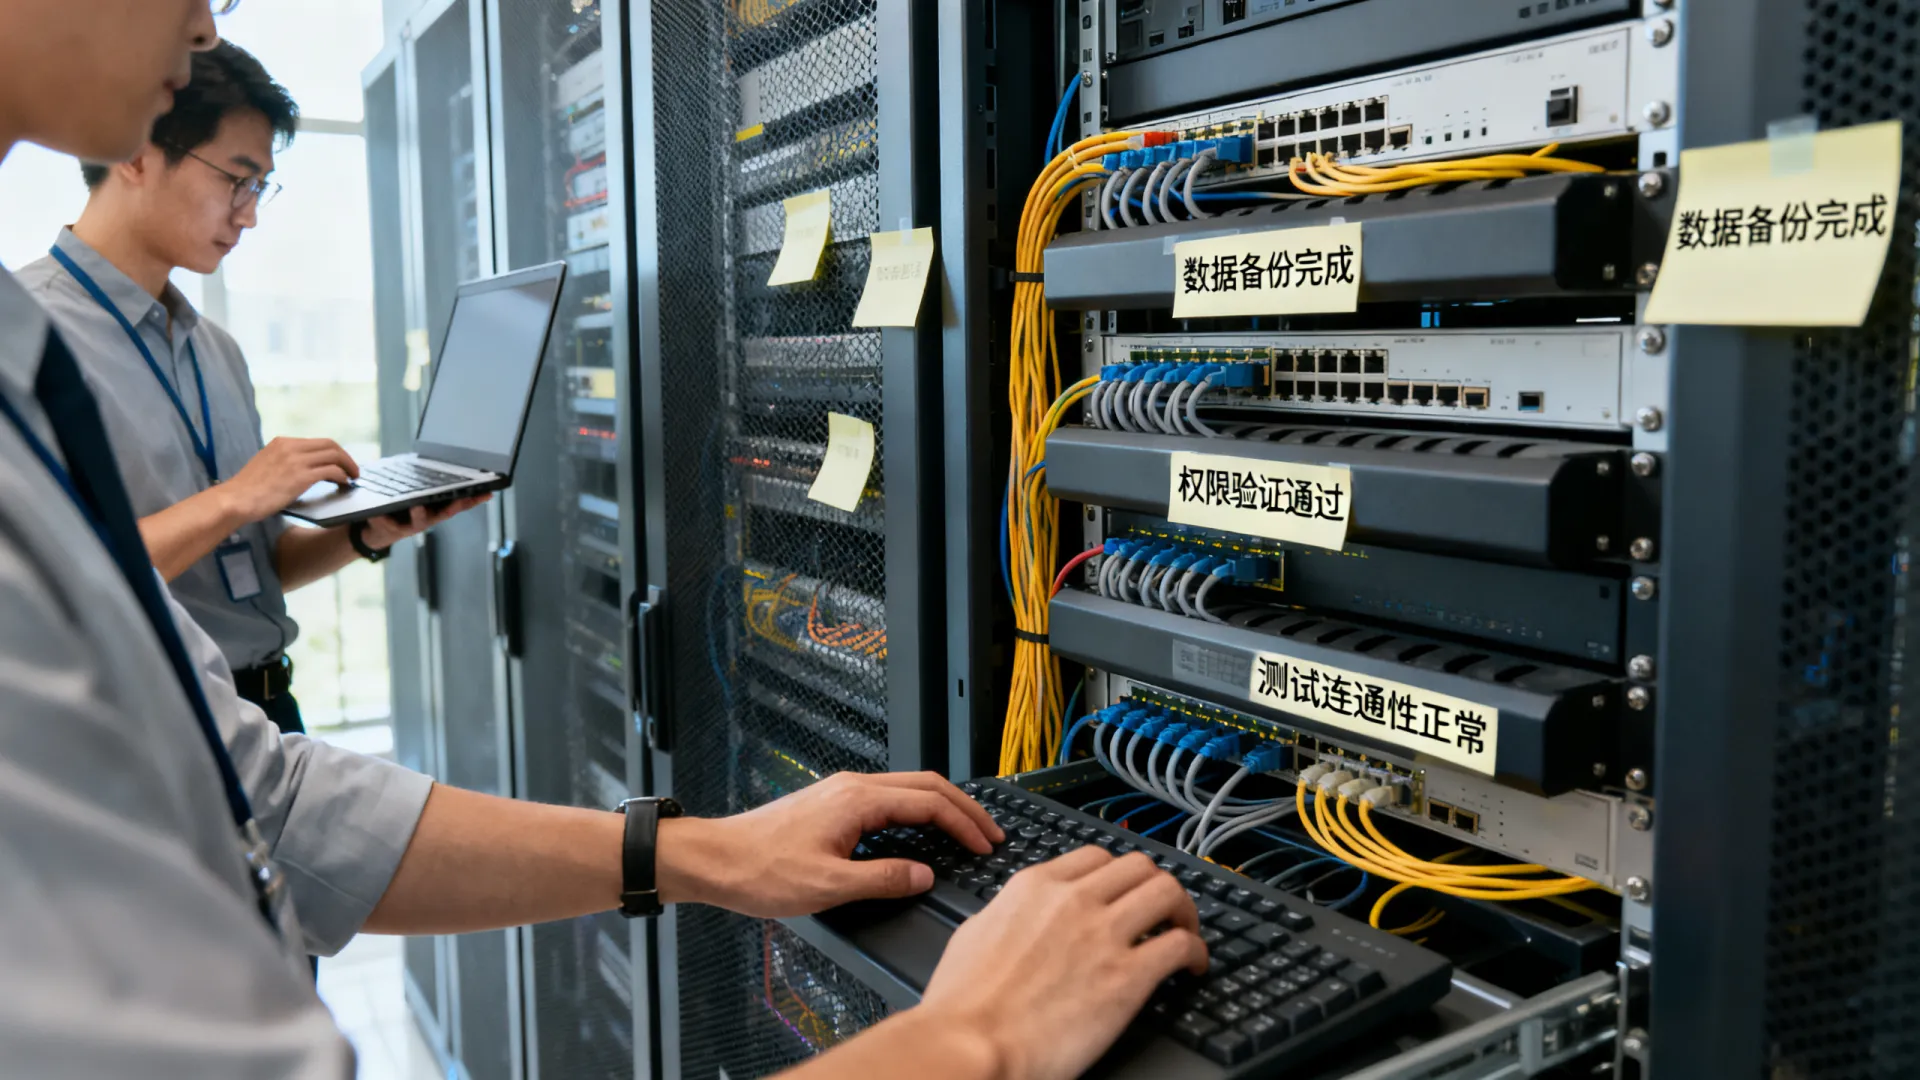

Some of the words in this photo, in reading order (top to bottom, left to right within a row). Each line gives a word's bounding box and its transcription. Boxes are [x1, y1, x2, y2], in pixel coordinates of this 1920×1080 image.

[1677, 193, 1888, 249] 数据备份完成
[1183, 244, 1354, 293] 数据备份完成
[1178, 465, 1344, 521] 权限验证通过
[1258, 656, 1487, 754] 测试连通性正常
